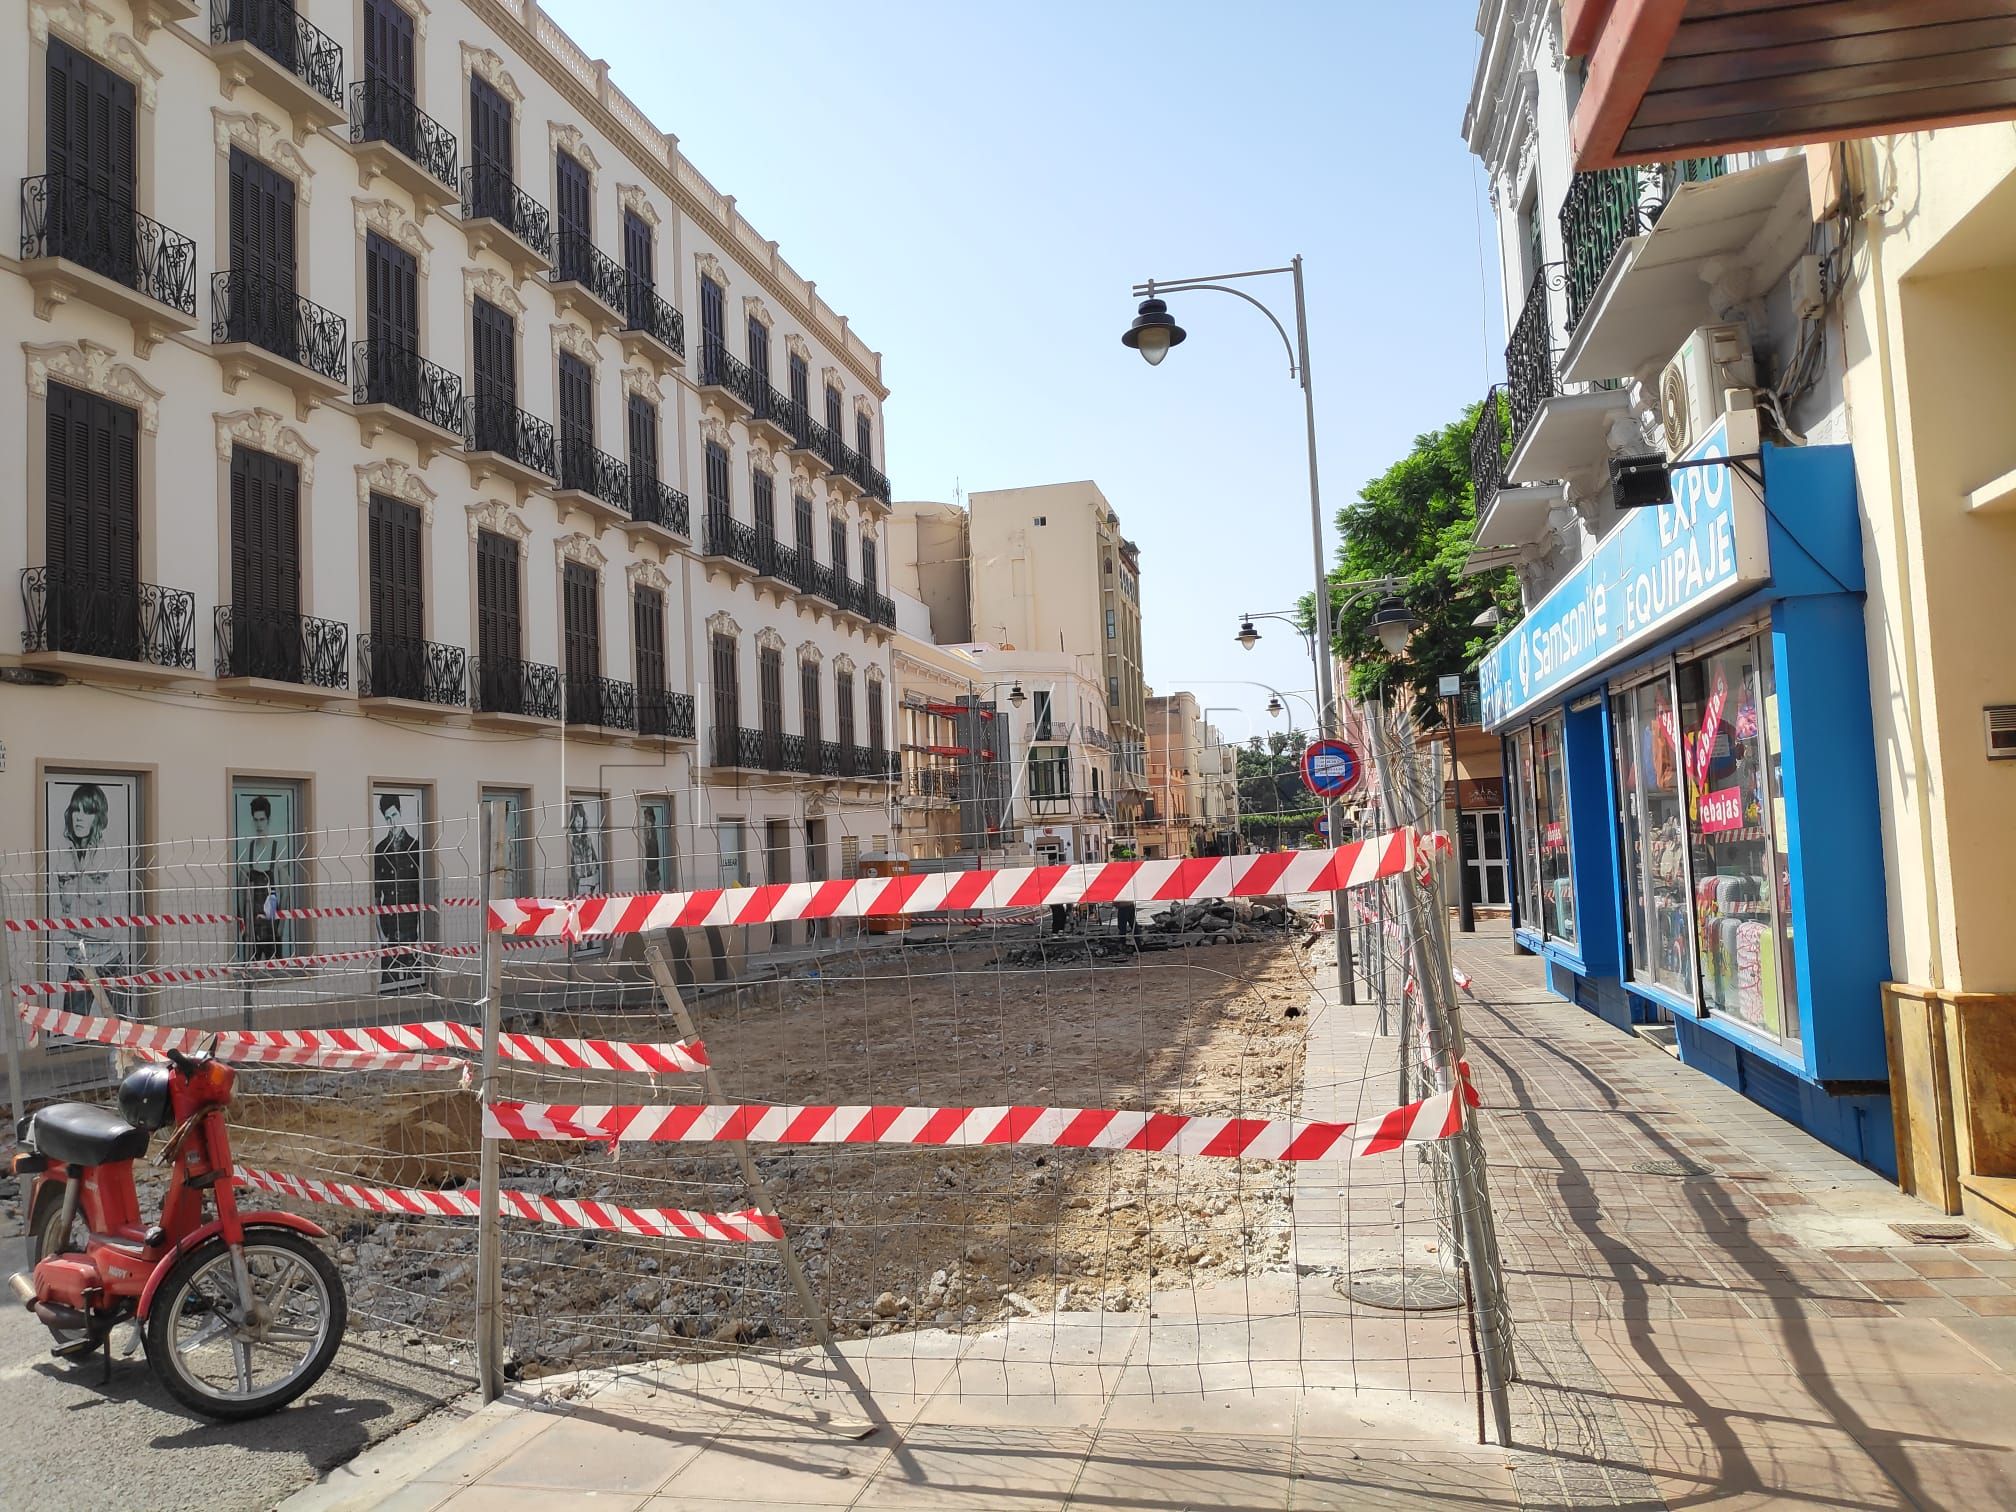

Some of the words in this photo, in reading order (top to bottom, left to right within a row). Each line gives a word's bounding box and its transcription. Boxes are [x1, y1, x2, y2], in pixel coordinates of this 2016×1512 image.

[1658, 445, 1724, 548] EXPO
[1626, 512, 1732, 632] EQUIPAJE
[1700, 794, 1740, 826] rebajas
